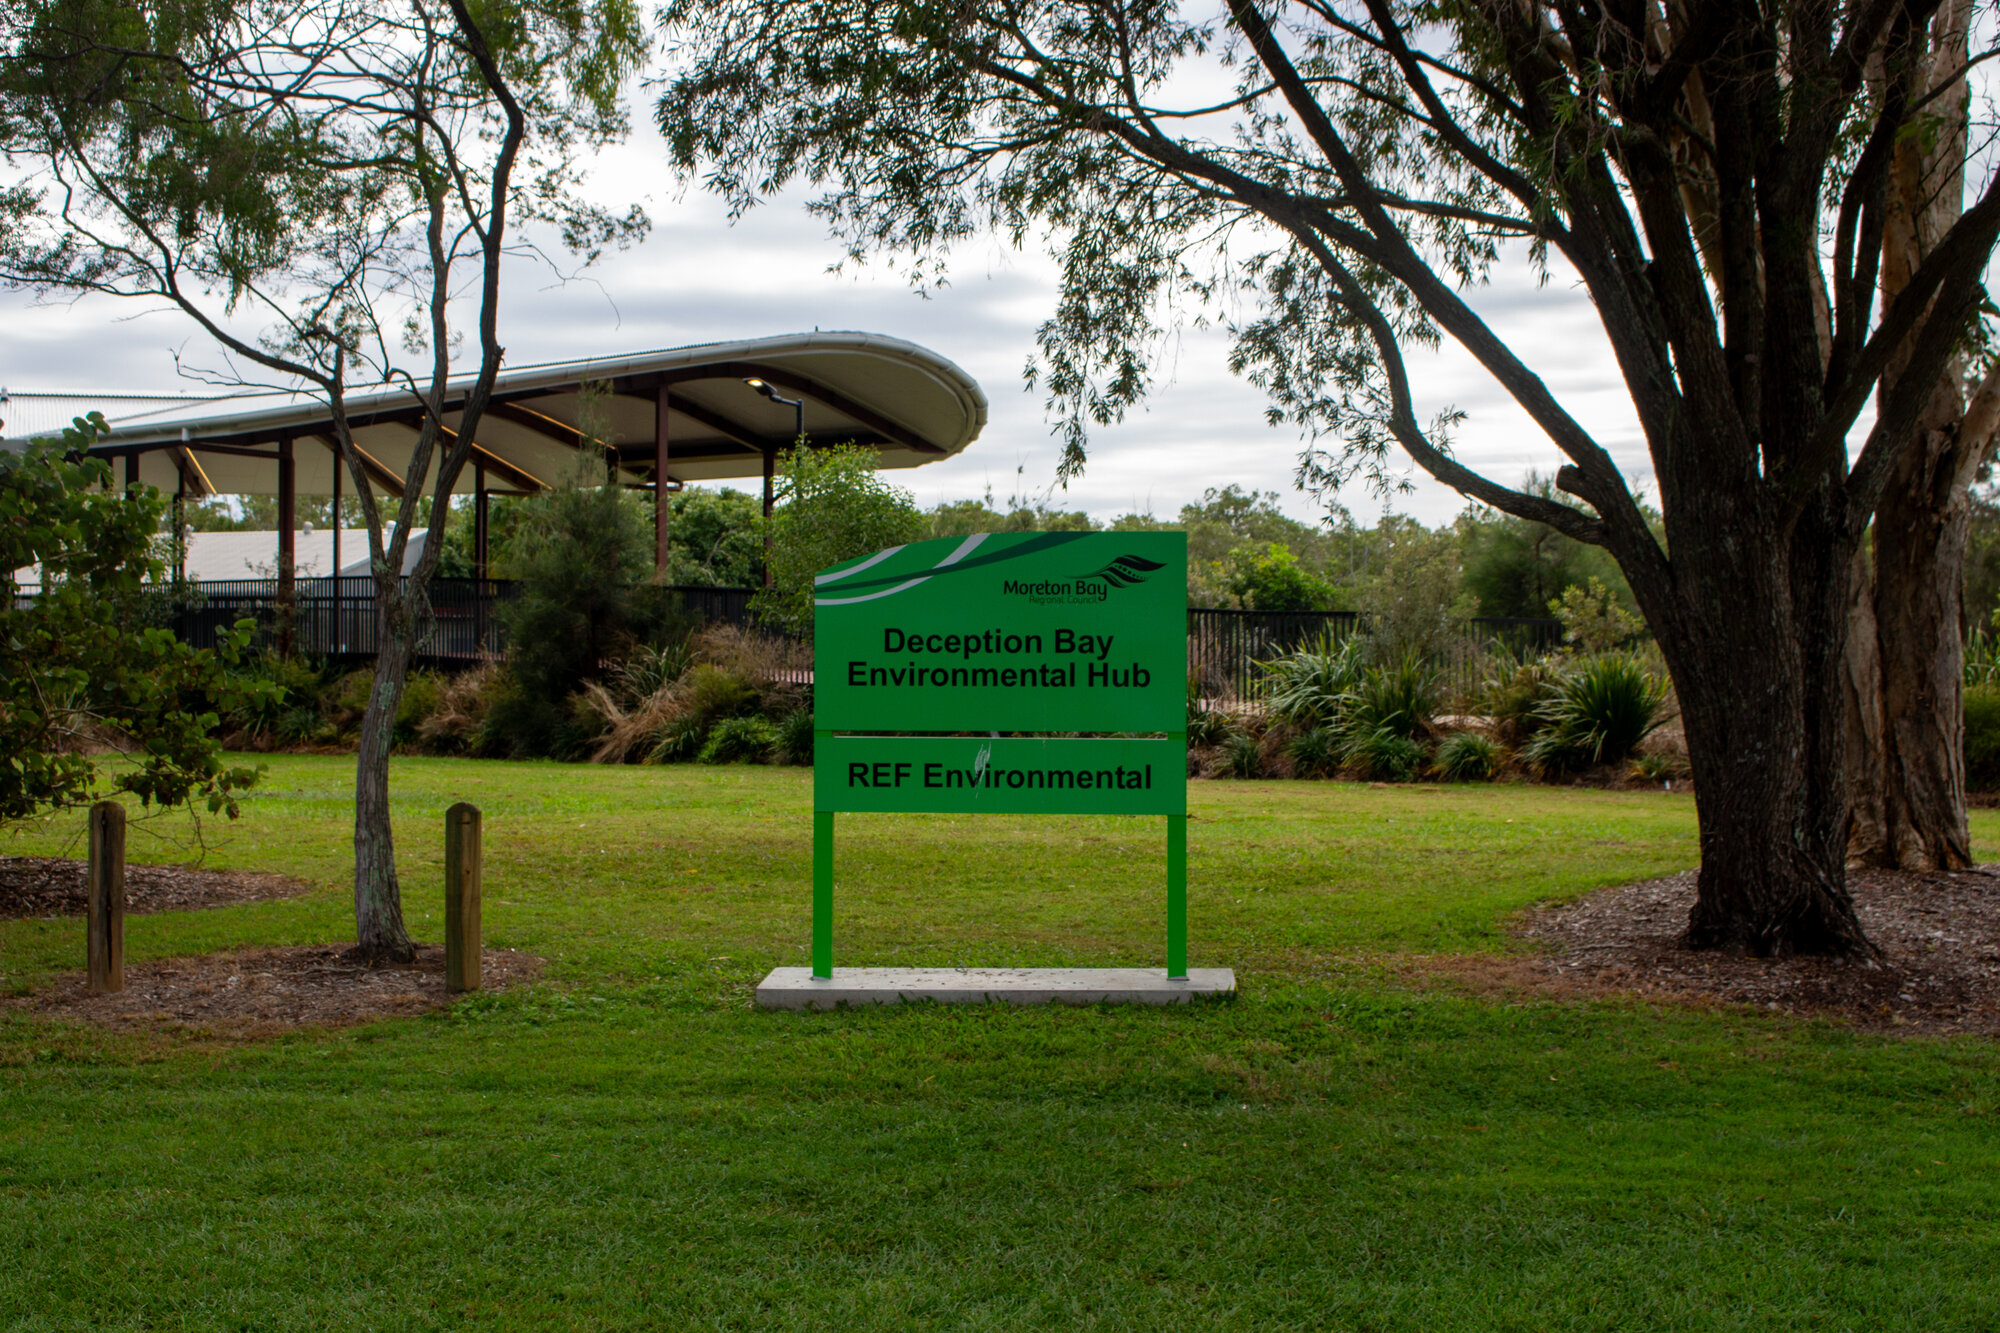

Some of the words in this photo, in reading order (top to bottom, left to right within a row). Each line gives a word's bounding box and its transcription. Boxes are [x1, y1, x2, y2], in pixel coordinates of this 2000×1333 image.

[1003, 580, 1071, 595] Moreton
[1075, 580, 1108, 602] Bay
[1029, 595, 1064, 605] Regional
[1067, 595, 1098, 604] Council
[884, 627, 1043, 660] Deception
[1054, 627, 1115, 660] Bay
[847, 660, 1076, 688] Environmental
[1087, 661, 1151, 688] Hub
[848, 762, 913, 788] REF
[923, 762, 1152, 789] Environmental
